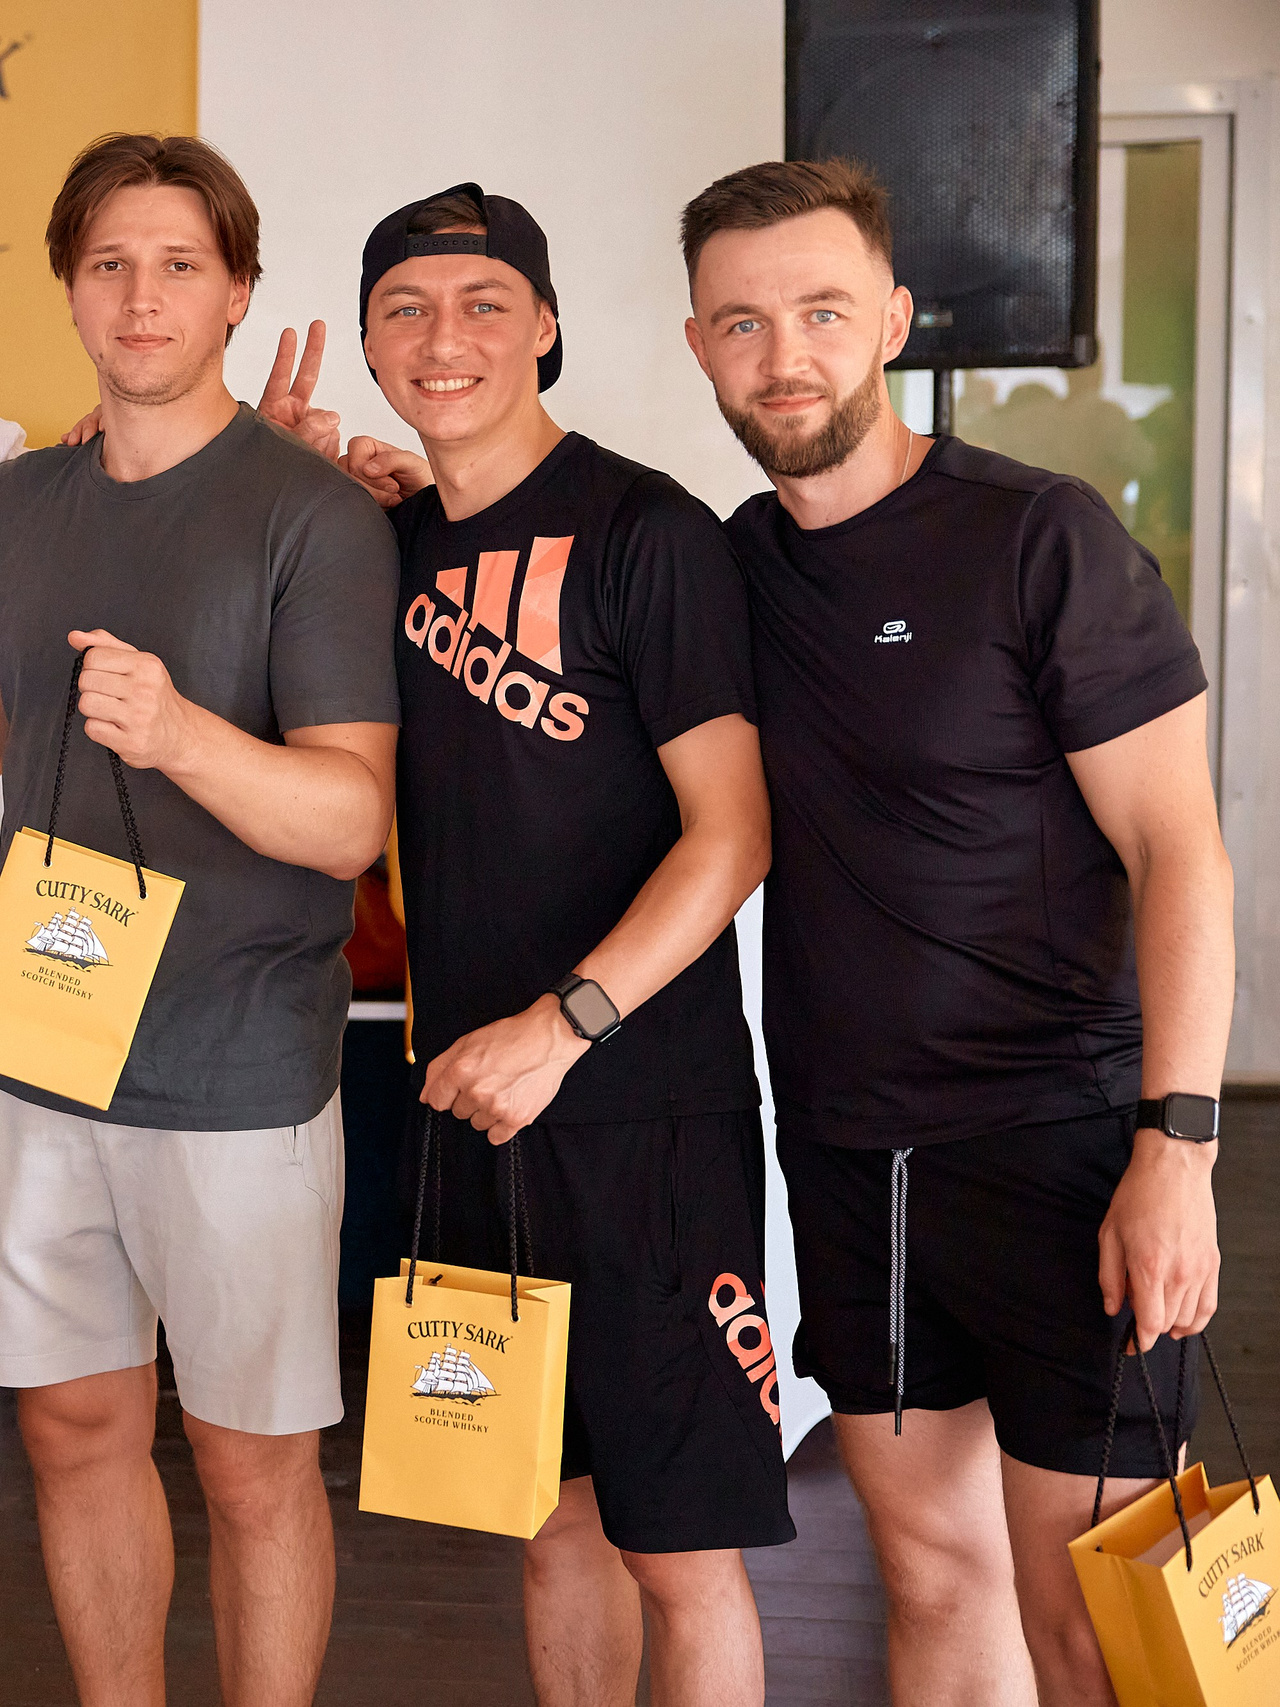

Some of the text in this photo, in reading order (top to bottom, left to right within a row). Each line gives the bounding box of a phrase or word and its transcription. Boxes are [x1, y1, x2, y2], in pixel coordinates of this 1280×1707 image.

[405, 593, 590, 741] adidas
[35, 879, 136, 927] CUTTY SARK
[20, 970, 93, 1000] SCOTCH WHISKY
[38, 966, 81, 986] BLENDED
[407, 1320, 510, 1354] CUTTY SARK
[414, 1415, 489, 1434] SCOTCH WHISKY
[430, 1408, 474, 1422] BLENDED
[1198, 1531, 1264, 1598] CUTTY SARK
[1242, 1626, 1271, 1655] BLENDED
[1236, 1648, 1260, 1672] SCOTCH
